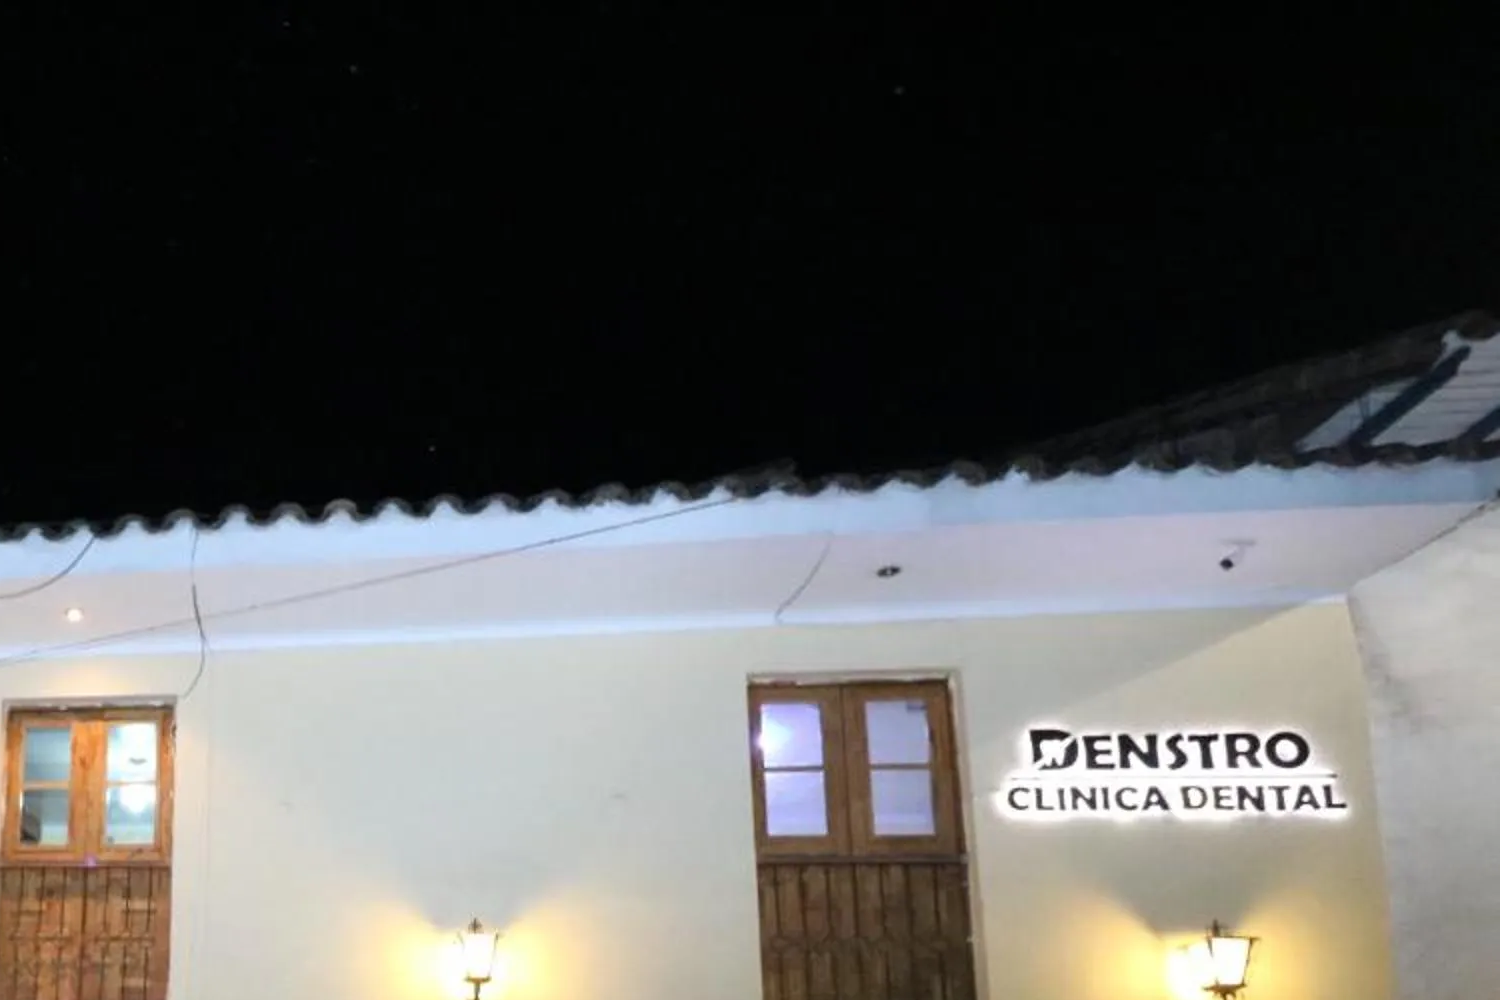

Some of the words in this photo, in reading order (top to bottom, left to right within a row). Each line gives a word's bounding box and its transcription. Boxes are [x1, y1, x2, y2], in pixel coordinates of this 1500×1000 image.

[1029, 729, 1311, 770] DENSTRO
[1007, 786, 1170, 812] CLINICA
[1179, 784, 1347, 812] DENTAL
